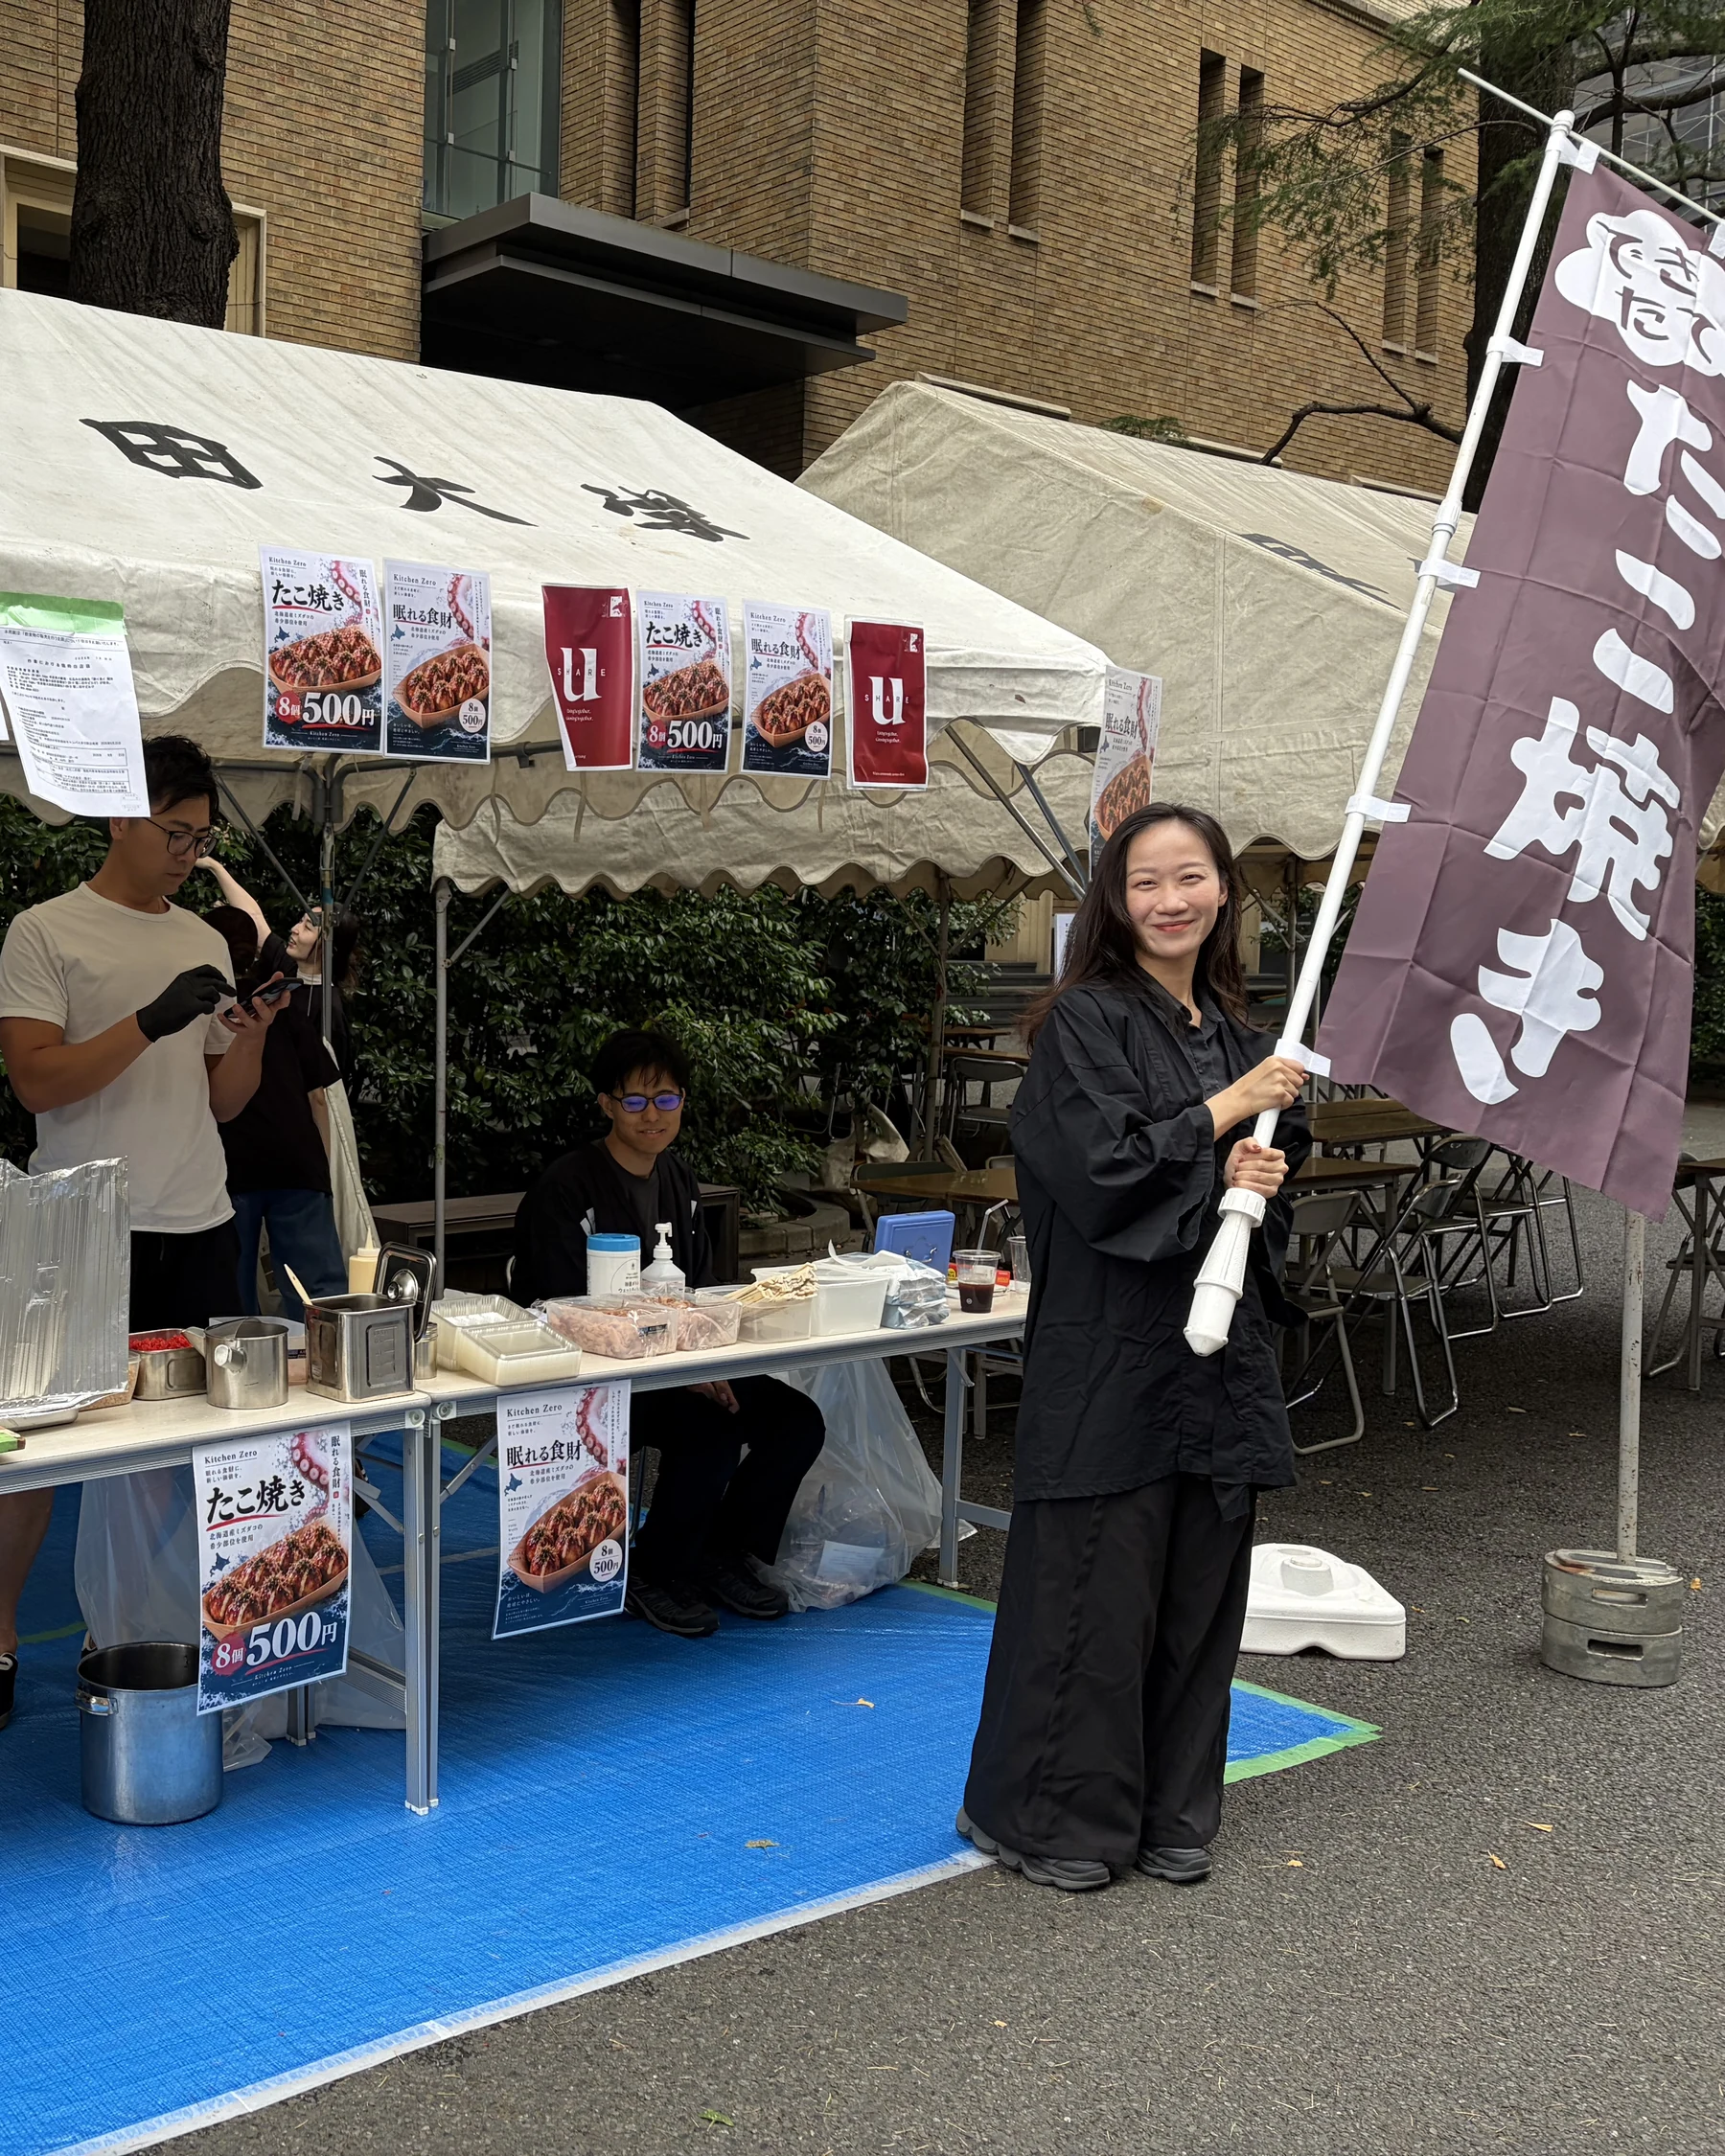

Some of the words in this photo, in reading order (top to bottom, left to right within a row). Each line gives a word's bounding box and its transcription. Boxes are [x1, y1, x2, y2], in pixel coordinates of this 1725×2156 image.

[268, 557, 291, 565] Kitchen
[393, 574, 420, 585] Kitchen
[422, 578, 437, 586] Zero
[271, 579, 345, 611] たこ焼き
[393, 604, 453, 629] 眠れる食財
[750, 612, 771, 621] Kitchen
[646, 621, 702, 648] たこ焼き
[750, 637, 801, 660] 眠れる食財
[278, 697, 301, 717] 8個
[302, 692, 375, 726] 500円
[864, 694, 909, 704] SHARE
[667, 720, 723, 749] 500円
[506, 1406, 540, 1418] Kitchen
[542, 1404, 563, 1413] Zero
[204, 1453, 237, 1464] Kitchen
[239, 1450, 258, 1459] Zero
[331, 1434, 341, 1489] 眠れる食財
[506, 1439, 583, 1467] 眠れる食財
[206, 1475, 306, 1525] たこ焼き
[593, 1559, 619, 1574] 500円
[216, 1642, 244, 1668] 8個
[245, 1611, 338, 1666] 500円
